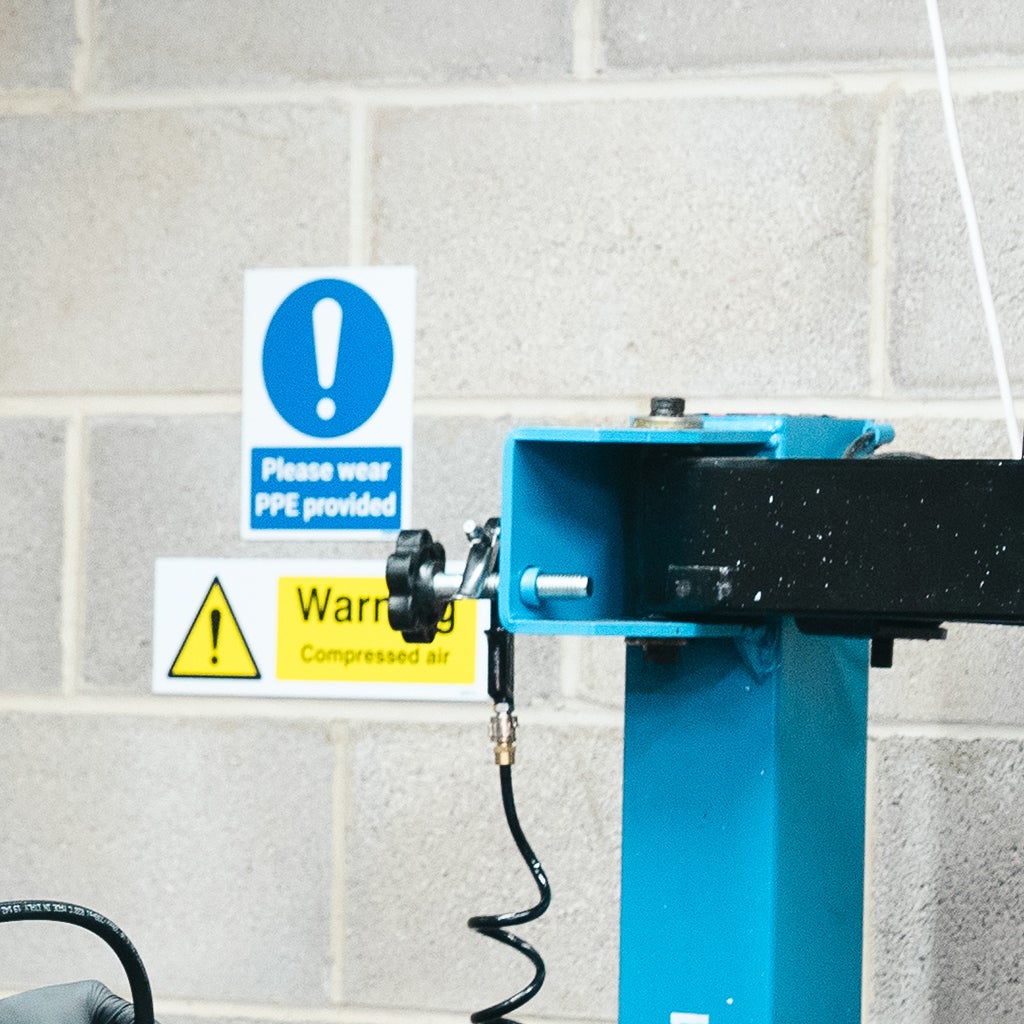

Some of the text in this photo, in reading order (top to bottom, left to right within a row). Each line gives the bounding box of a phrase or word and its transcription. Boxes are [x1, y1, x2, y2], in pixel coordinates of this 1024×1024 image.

[261, 456, 391, 482] Please wear
[255, 490, 397, 522] PPE provided
[300, 644, 450, 667] Compressed air
